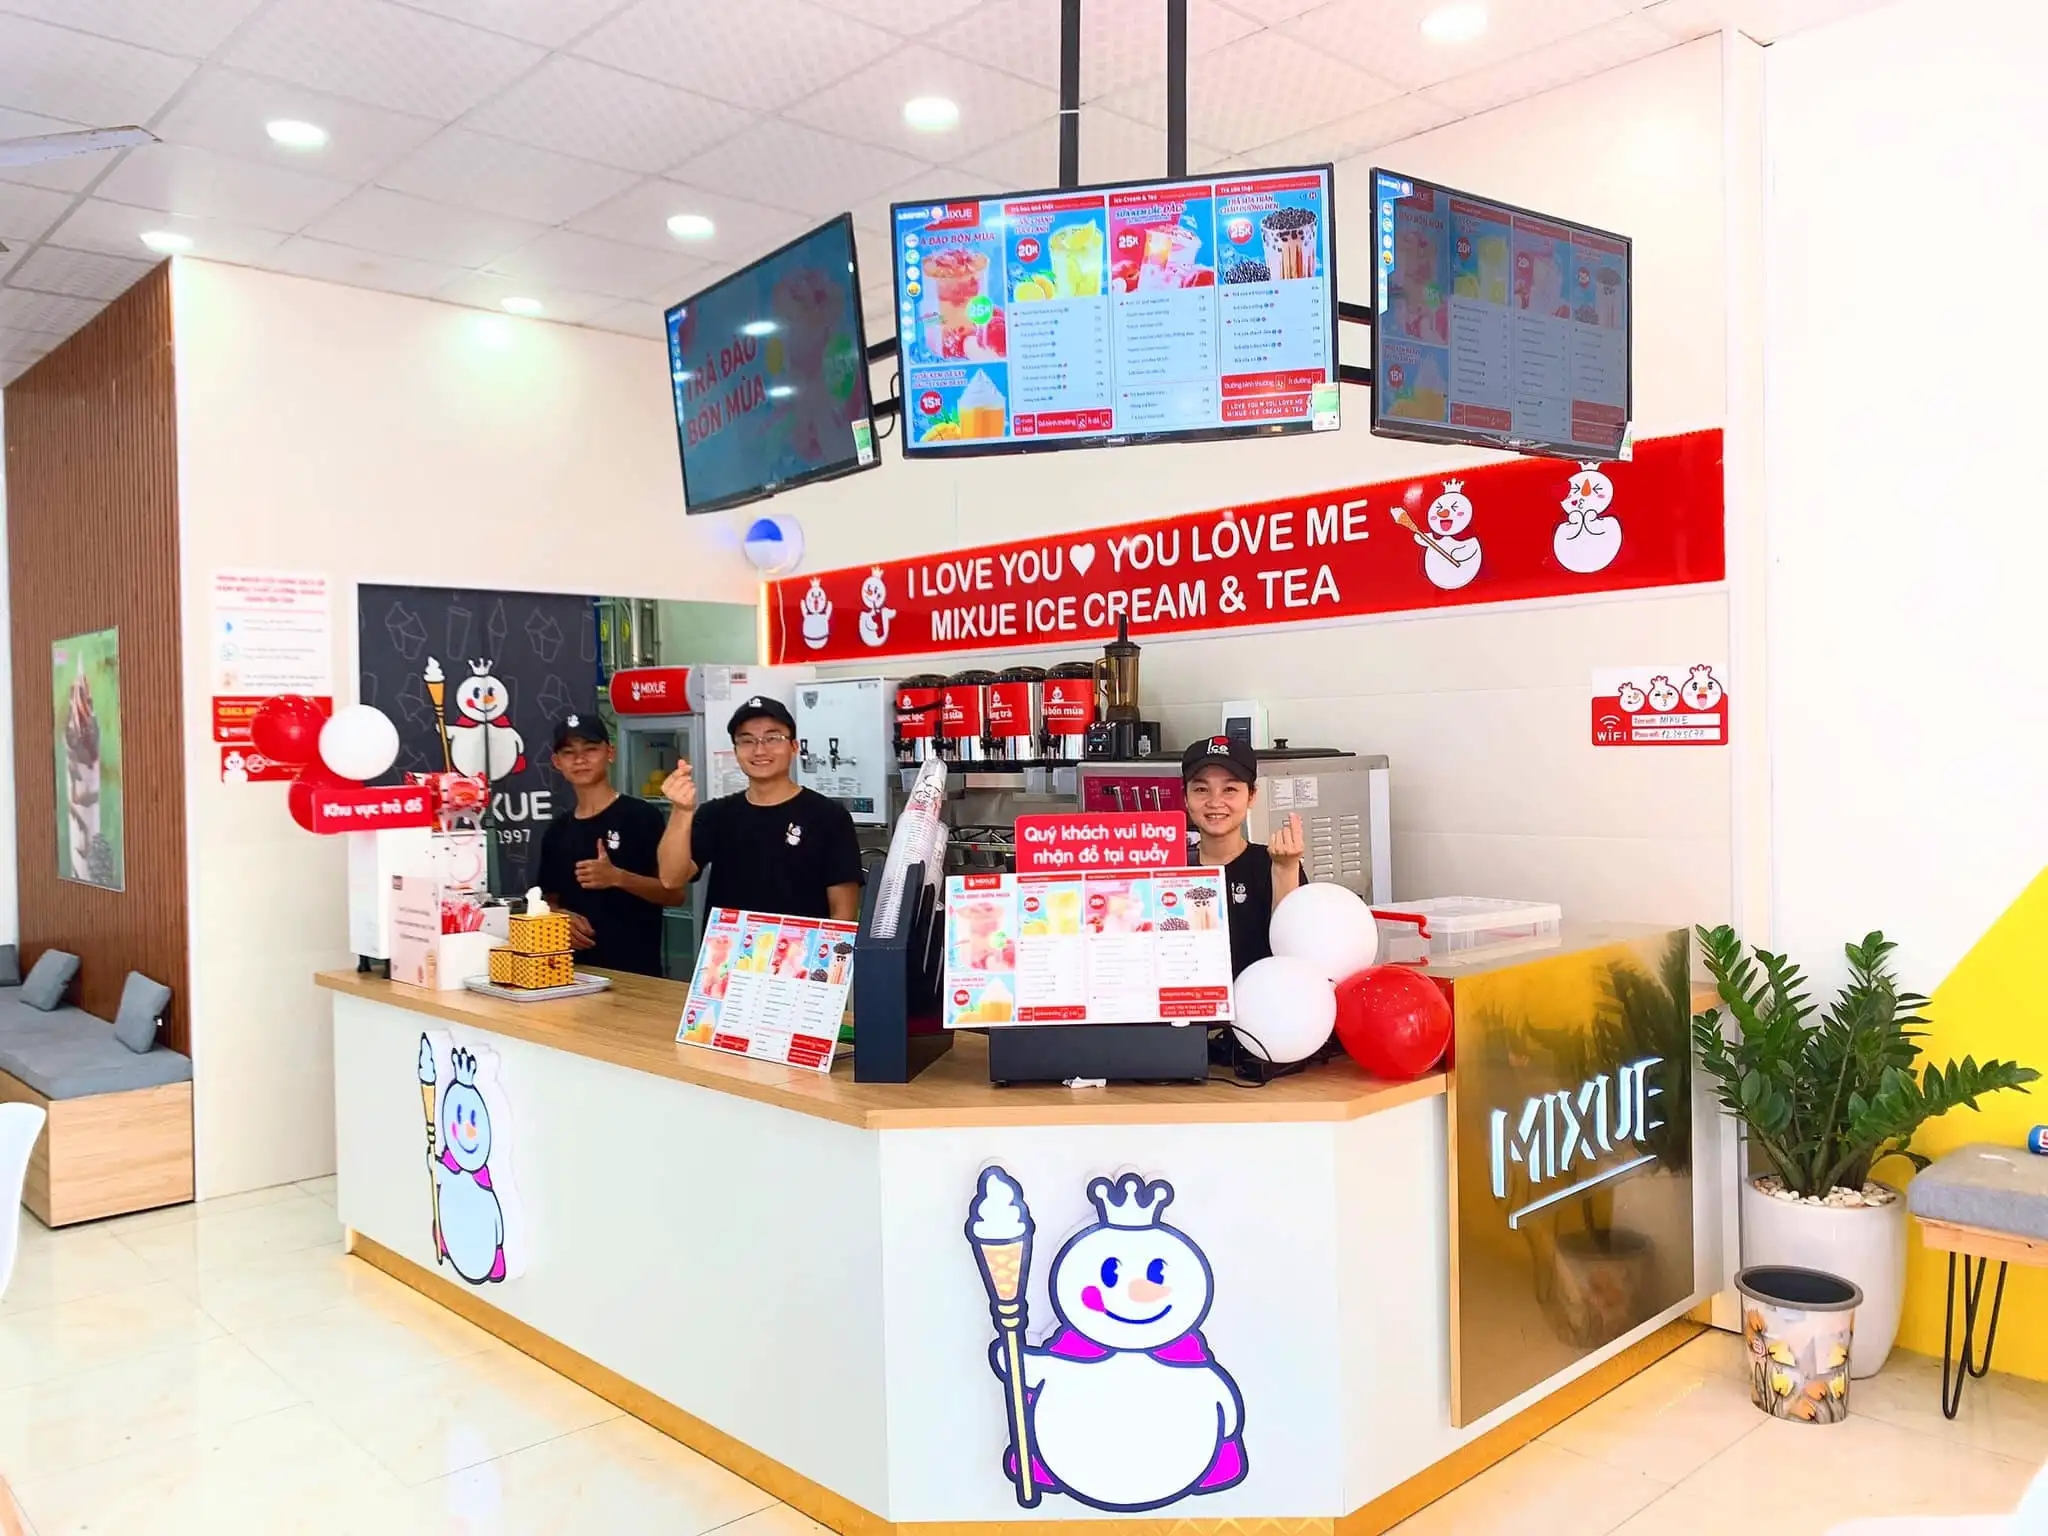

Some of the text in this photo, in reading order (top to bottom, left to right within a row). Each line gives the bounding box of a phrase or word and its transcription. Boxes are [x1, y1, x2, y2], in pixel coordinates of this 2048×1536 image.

[1118, 235, 1139, 248] 25K
[1230, 223, 1251, 238] 25K
[907, 498, 1370, 600] I LOVE YOU YOU LOVE ME
[931, 563, 1342, 643] MIXUE ICE CREAM & TEA
[640, 680, 667, 694] MIXUE
[322, 803, 353, 818] Khu
[492, 790, 553, 822] XUE
[497, 828, 531, 844] 1997
[1024, 820, 1177, 846] Quý khách vui lòng
[1033, 846, 1075, 868] nhận
[1103, 846, 1124, 866] tại
[1490, 1057, 1665, 1199] MIXUE
